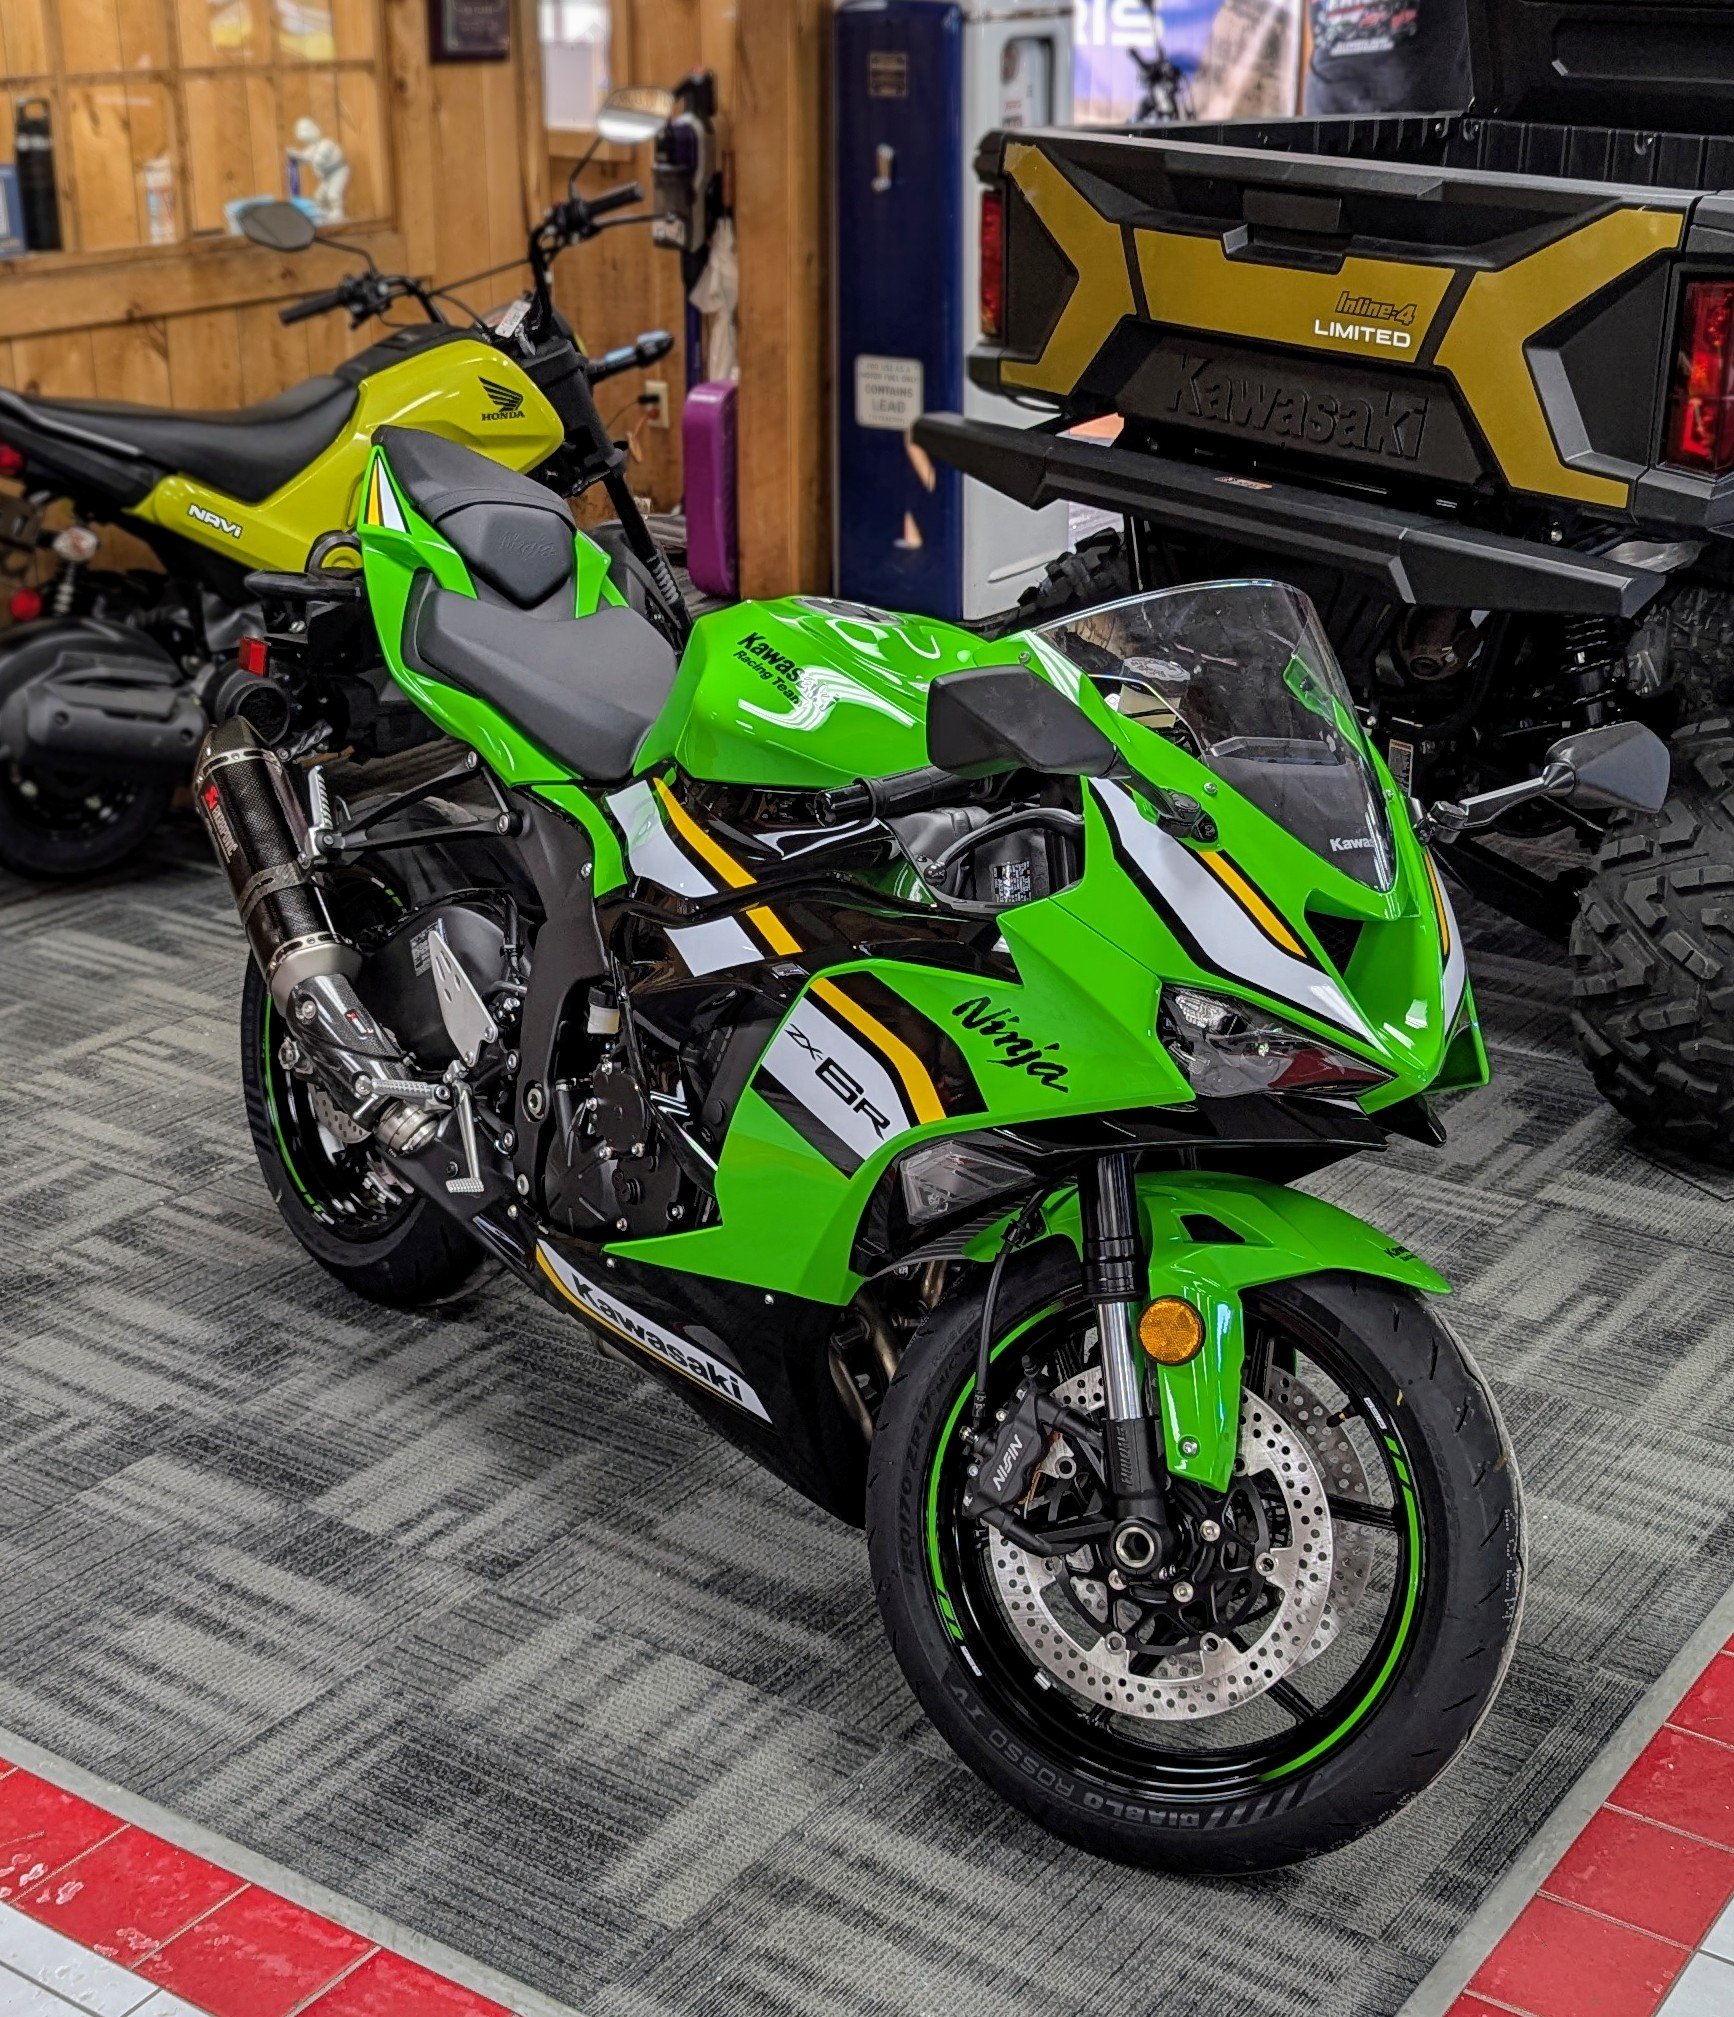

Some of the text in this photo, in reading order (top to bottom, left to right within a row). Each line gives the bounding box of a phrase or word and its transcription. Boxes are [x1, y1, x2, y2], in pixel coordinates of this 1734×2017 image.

[1335, 290, 1418, 326] Inline-4
[1314, 319, 1411, 348] LIMITED
[865, 383, 914, 398] CONTAINS
[872, 399, 906, 414] LEAD
[1167, 354, 1431, 461] Kawasaki
[481, 411, 526, 421] HONDA
[733, 650, 773, 680] Racing
[952, 996, 1069, 1093] Ninja
[784, 1023, 891, 1141] ZX-6R
[572, 1273, 743, 1402] Kawasaki
[993, 1433, 1023, 1492] NISSIN
[952, 1686, 1200, 1829] DIABLO ROSSO IV
